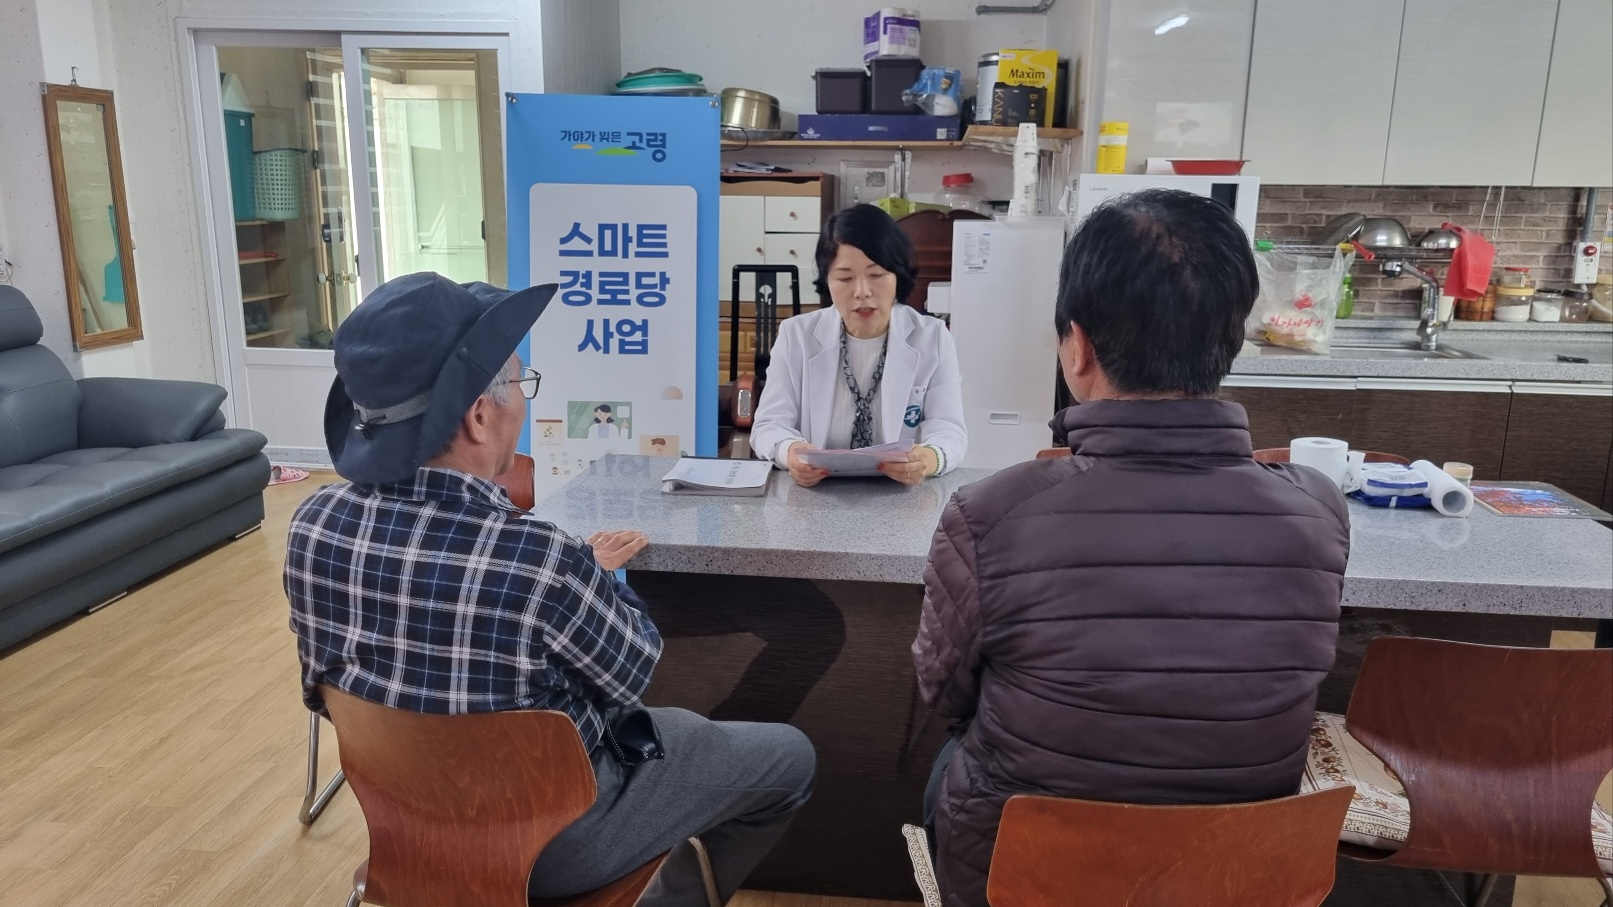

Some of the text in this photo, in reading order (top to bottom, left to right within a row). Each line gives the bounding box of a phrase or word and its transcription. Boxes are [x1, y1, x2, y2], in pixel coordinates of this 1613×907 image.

[1009, 68, 1045, 79] Maxim
[992, 89, 1004, 126] KANU
[560, 130, 667, 163] 가야가 빚은 고령
[559, 222, 669, 259] 스마트
[559, 270, 671, 307] 경로당
[578, 318, 649, 355] 사업
